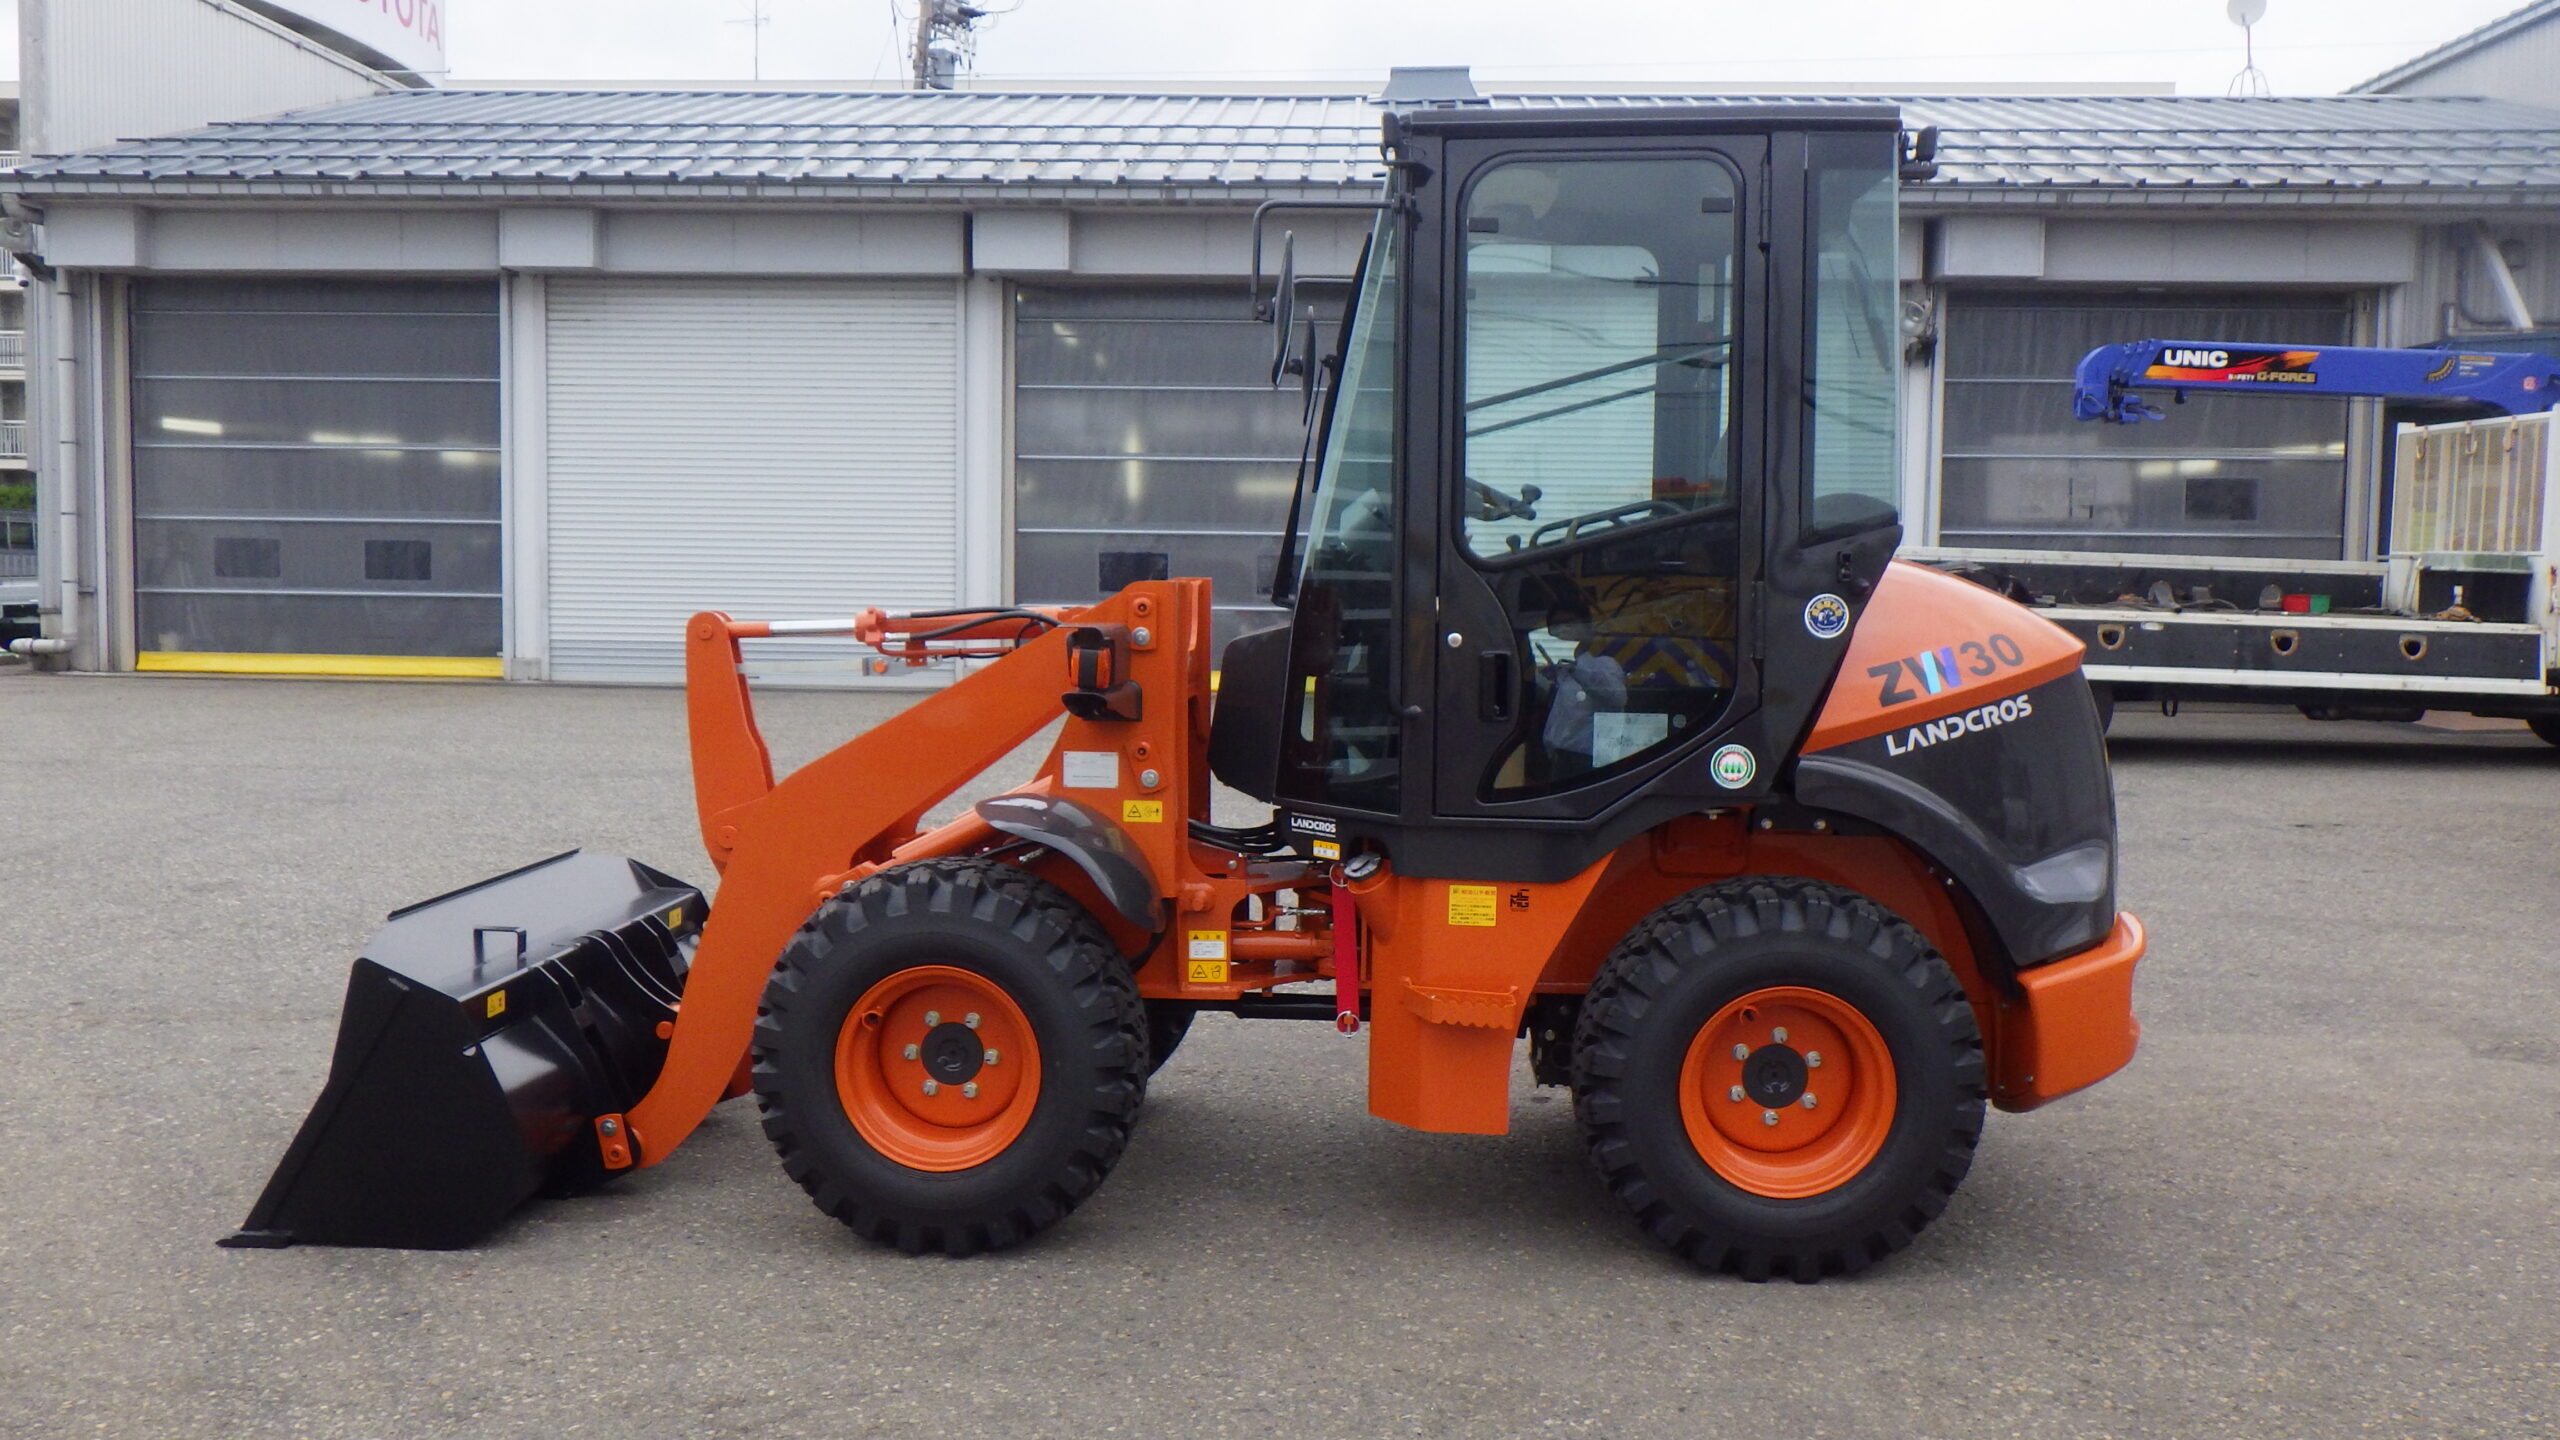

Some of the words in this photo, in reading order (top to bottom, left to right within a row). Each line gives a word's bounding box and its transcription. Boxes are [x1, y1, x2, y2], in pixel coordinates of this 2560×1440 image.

[2164, 349, 2229, 368] UNIC
[1867, 633, 2025, 708] ZW30
[1885, 694, 2033, 757] LANDCROS
[1291, 816, 1336, 833] LANDCROS
